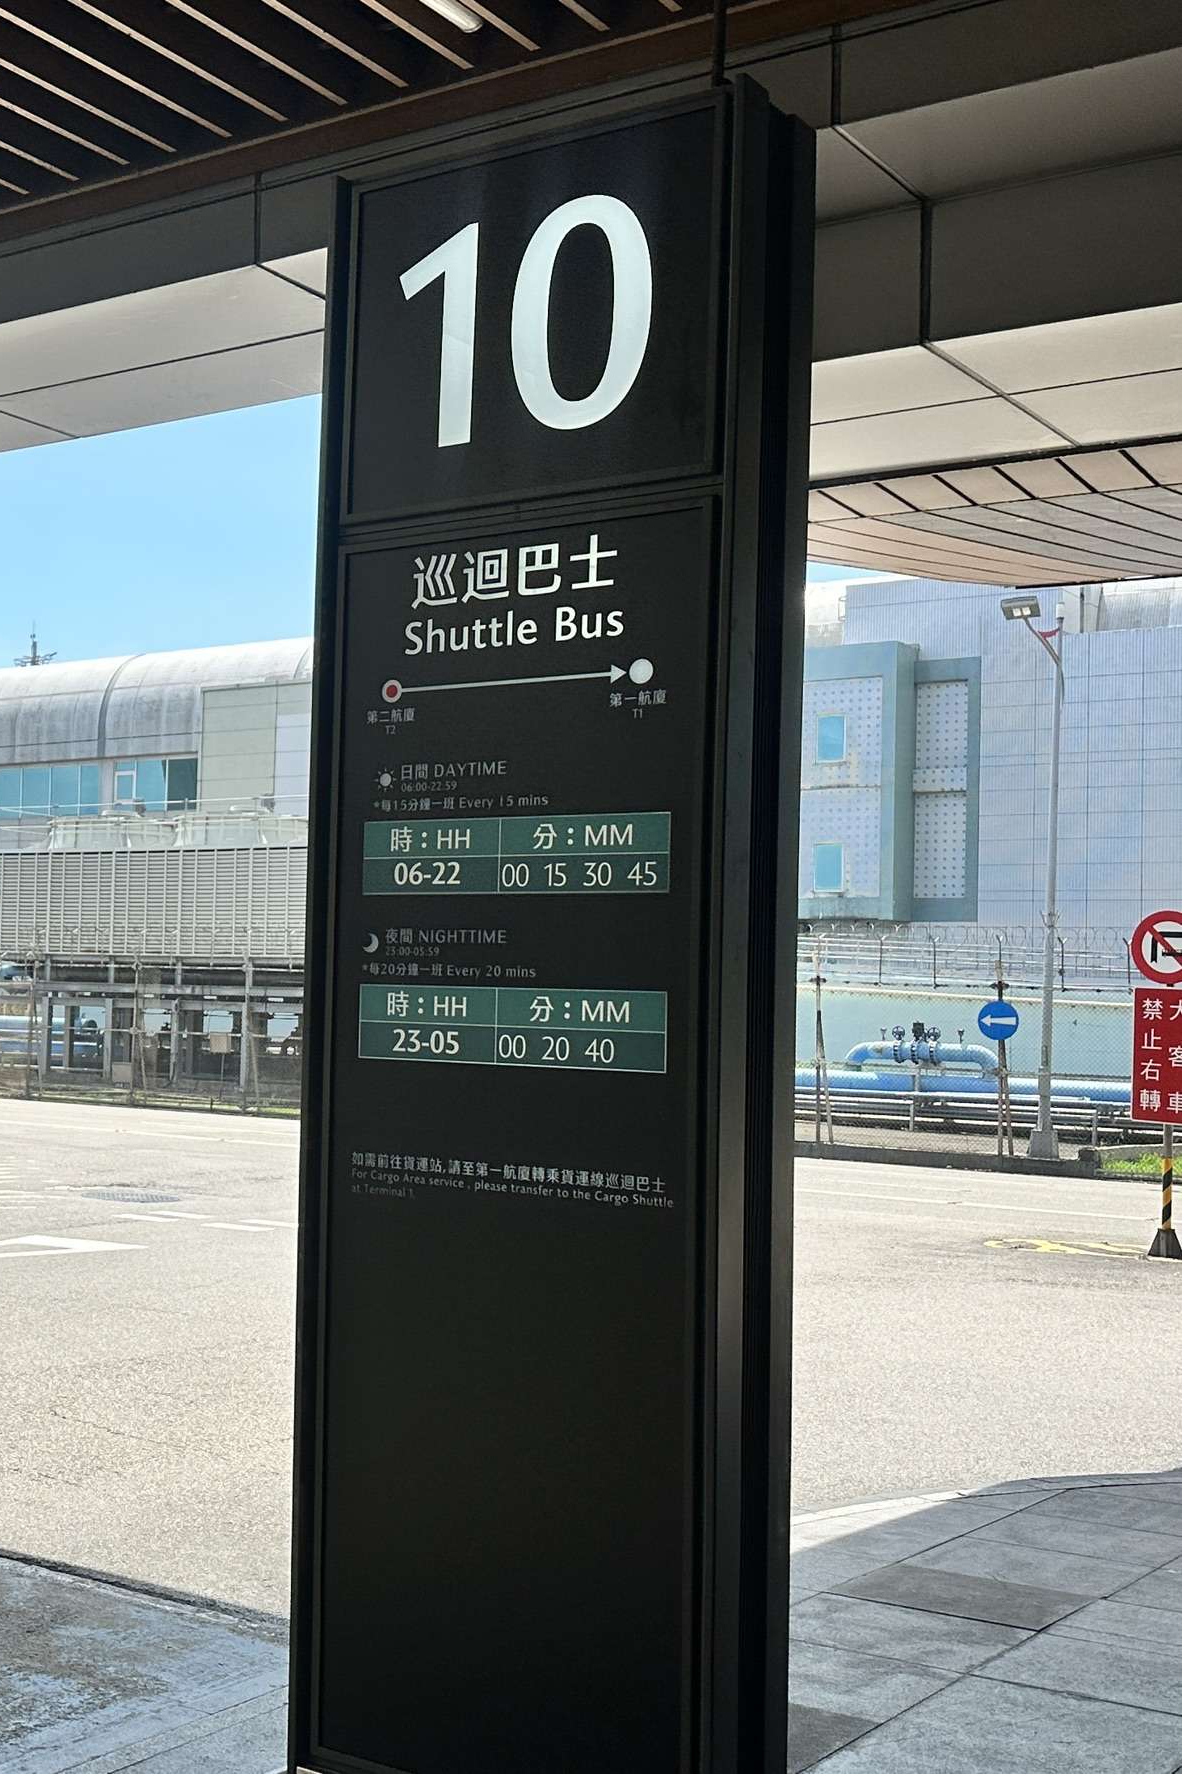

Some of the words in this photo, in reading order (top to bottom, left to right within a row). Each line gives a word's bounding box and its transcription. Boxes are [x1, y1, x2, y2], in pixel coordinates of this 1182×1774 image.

[399, 194, 653, 447] 10
[411, 534, 618, 609] 巡迴巴士
[404, 610, 538, 655] Shuttle
[555, 606, 624, 641] Bus
[609, 690, 667, 707] 第一航廈
[367, 707, 415, 724] 第二航廈
[632, 708, 644, 719] T1
[384, 725, 397, 735] T2
[401, 764, 428, 780] 日間
[434, 761, 507, 778] DAYTIME
[459, 797, 494, 810] Every
[499, 795, 515, 807] 15
[518, 793, 549, 806] mins
[394, 862, 461, 885] 06-22
[501, 863, 529, 887] 00
[544, 863, 567, 887] 15
[583, 862, 612, 886] 30
[627, 862, 657, 886] 45
[385, 928, 413, 945] 夜間
[419, 929, 507, 944] NIGHTTIME
[447, 965, 482, 980] Every
[486, 964, 502, 977] 20
[506, 966, 537, 978] mins
[392, 1029, 460, 1055] 23-05
[498, 1034, 527, 1059] 00
[541, 1036, 570, 1062] 20
[584, 1038, 616, 1064] 40
[1139, 998, 1164, 1112] 禁止右轉
[351, 1168, 367, 1178] For
[370, 1170, 400, 1184] Cargo
[403, 1174, 426, 1185] Area
[474, 1180, 508, 1193] please
[510, 1183, 554, 1197] transfer
[557, 1188, 569, 1199] to
[573, 1189, 591, 1200] the
[594, 1191, 629, 1206] Cargo
[632, 1194, 675, 1209] Shuttle
[364, 1184, 406, 1198] Terminal
